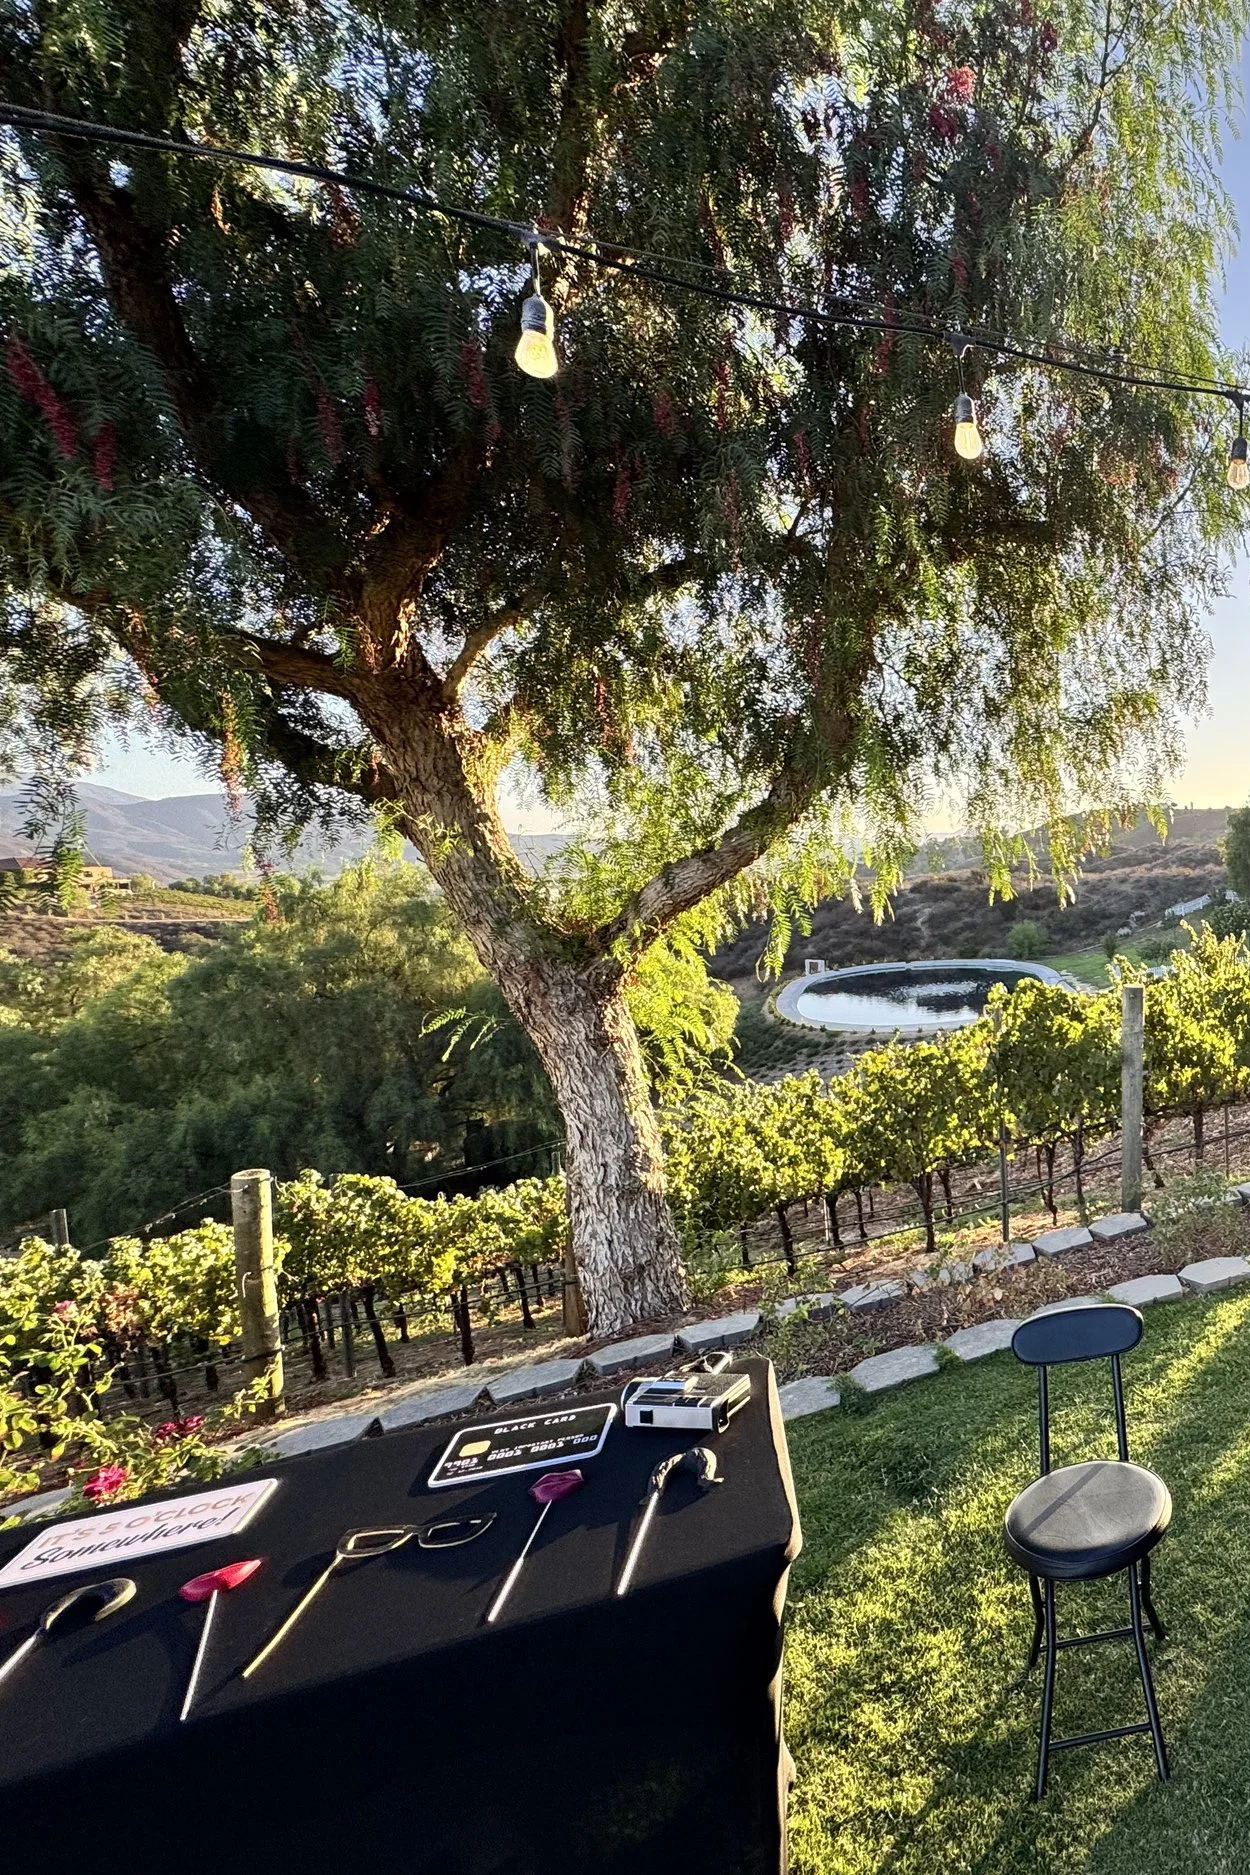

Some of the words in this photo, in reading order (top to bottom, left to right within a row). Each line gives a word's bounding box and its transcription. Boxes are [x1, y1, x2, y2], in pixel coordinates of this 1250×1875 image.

[494, 1422, 536, 1435] BLACK
[544, 1414, 576, 1425] CARD
[514, 1440, 554, 1450] IMPORTANT
[20, 1507, 241, 1570] Somewhere!
[38, 1526, 93, 1548] IT'S
[98, 1522, 120, 1536] 5
[124, 1491, 256, 1529] O'CLOCK
